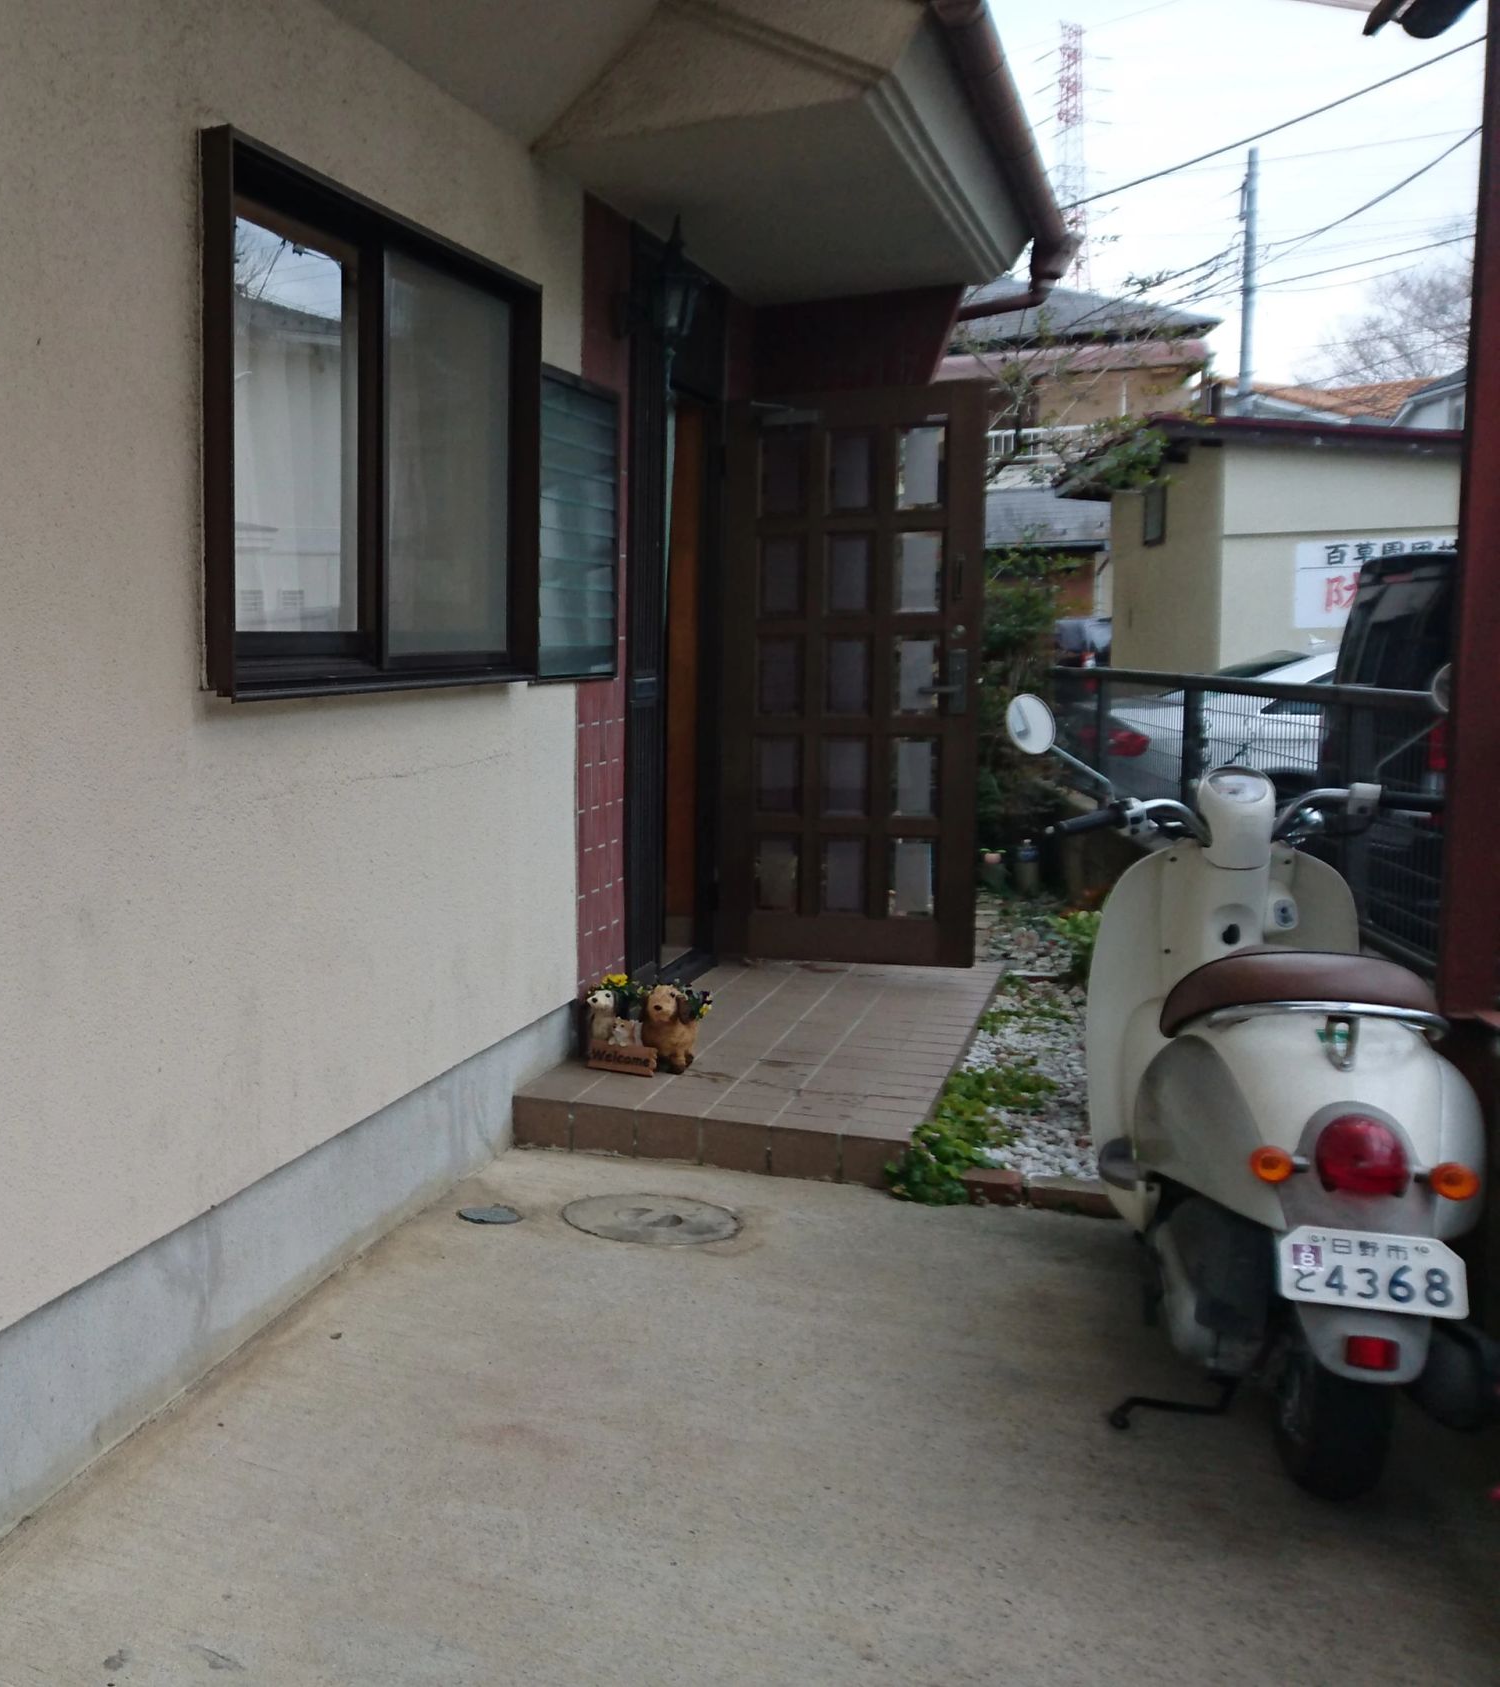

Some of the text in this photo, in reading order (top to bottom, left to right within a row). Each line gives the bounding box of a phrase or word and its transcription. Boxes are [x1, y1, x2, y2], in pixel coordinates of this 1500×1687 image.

[591, 1048, 651, 1068] Welcome
[1331, 1237, 1410, 1261] 日野市
[1324, 1264, 1455, 1309] 4368
